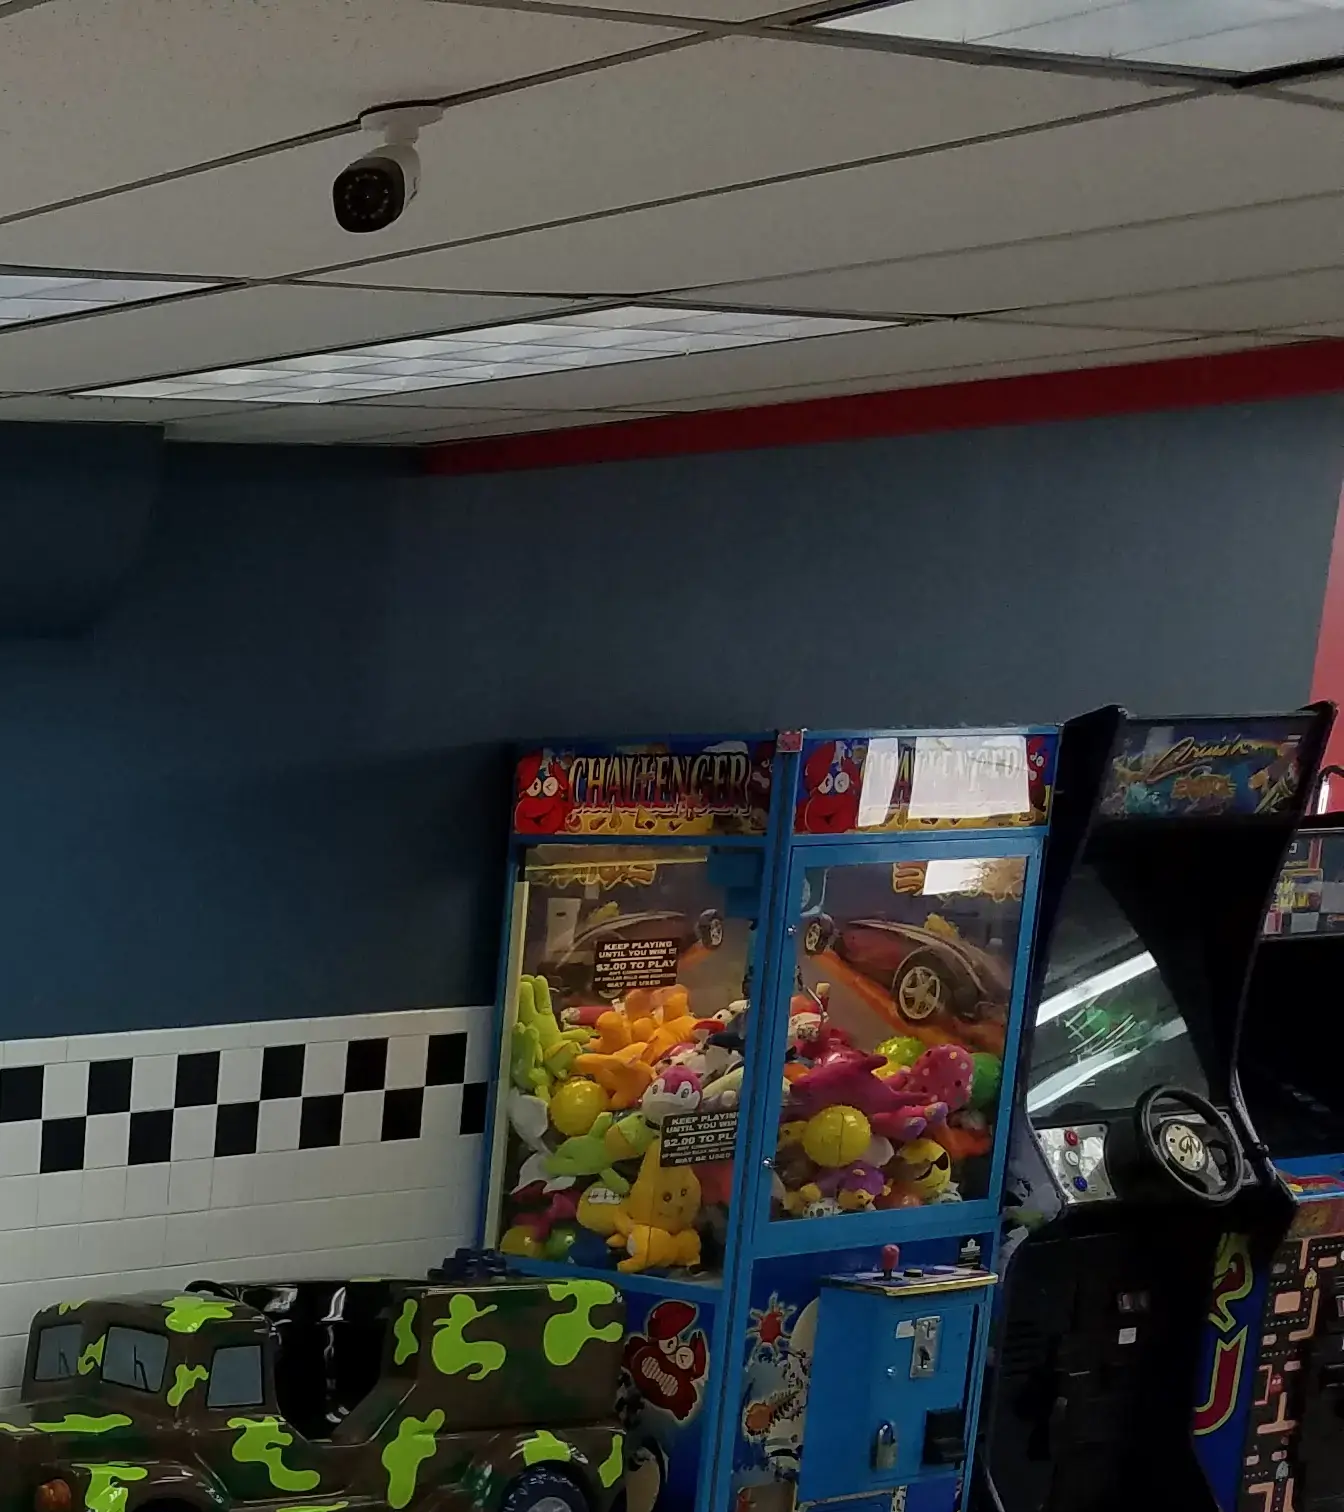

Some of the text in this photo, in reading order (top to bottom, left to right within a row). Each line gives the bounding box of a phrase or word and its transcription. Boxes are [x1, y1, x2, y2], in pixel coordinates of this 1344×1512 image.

[567, 755, 752, 814] CHALLENGER
[604, 941, 673, 951] KEEP PLAYING
[629, 949, 647, 957] YOU
[596, 963, 627, 972] $2.00
[630, 961, 645, 969] TO
[648, 959, 677, 968] PLAY
[666, 1120, 737, 1133] UNTIL YOU WIN
[672, 1117, 698, 1125] KEEP
[664, 1137, 695, 1147] $2.00
[699, 1135, 715, 1143] TO
[718, 1133, 737, 1141] PLA
